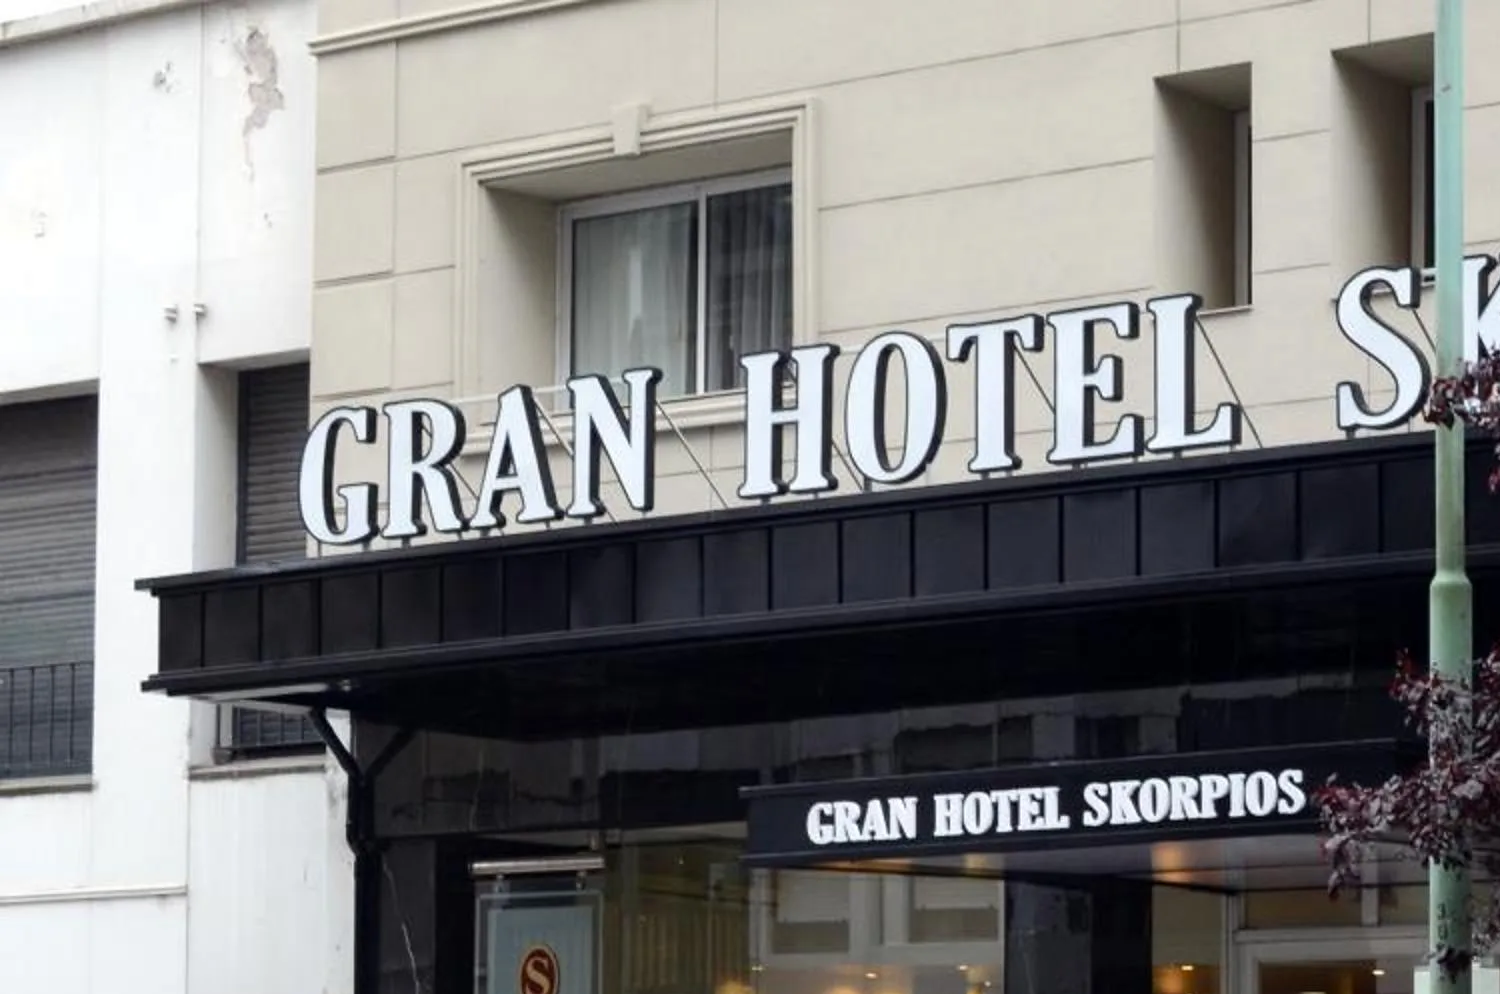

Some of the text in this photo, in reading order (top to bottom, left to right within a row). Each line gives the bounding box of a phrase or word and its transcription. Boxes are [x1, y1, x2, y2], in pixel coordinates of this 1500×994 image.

[297, 367, 661, 546] GRAN
[737, 293, 1243, 499] HOTEL
[806, 768, 1306, 844] GRAN HOTEL SKORPIOS
